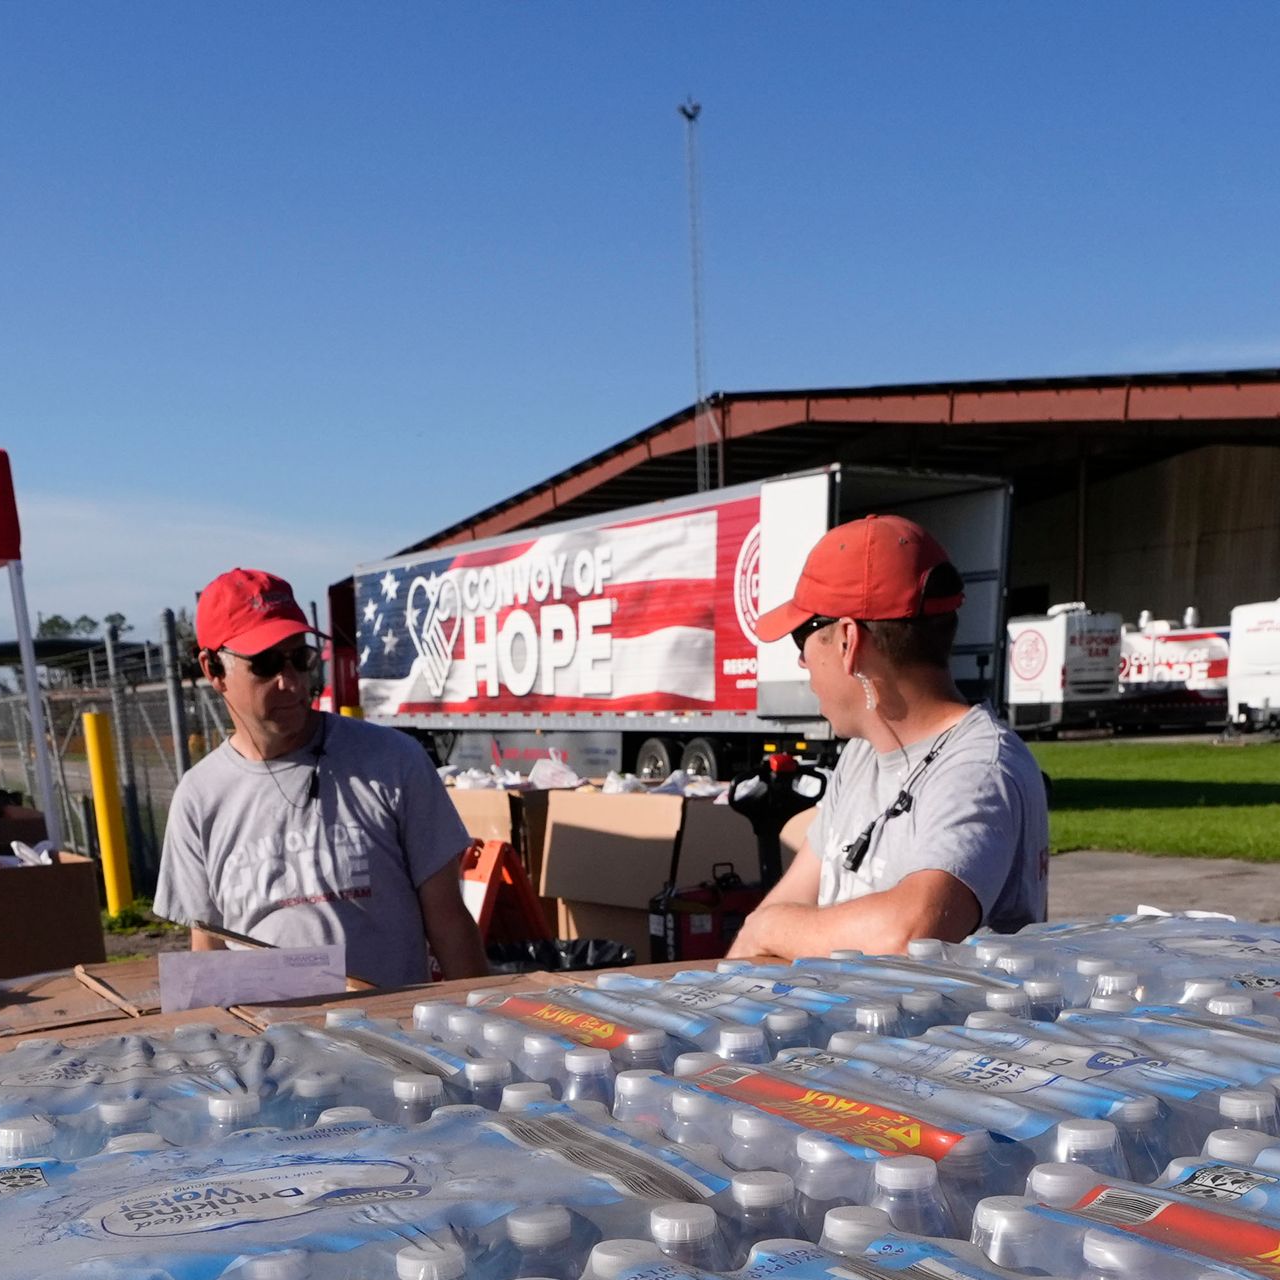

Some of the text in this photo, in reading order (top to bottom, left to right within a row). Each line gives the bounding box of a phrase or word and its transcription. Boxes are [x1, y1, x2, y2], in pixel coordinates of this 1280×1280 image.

[463, 547, 612, 611] CONVOY OF
[463, 598, 613, 697] HOPE
[723, 657, 757, 675] RESPO
[119, 1187, 240, 1213] Water
[124, 1186, 305, 1222] Drinking
